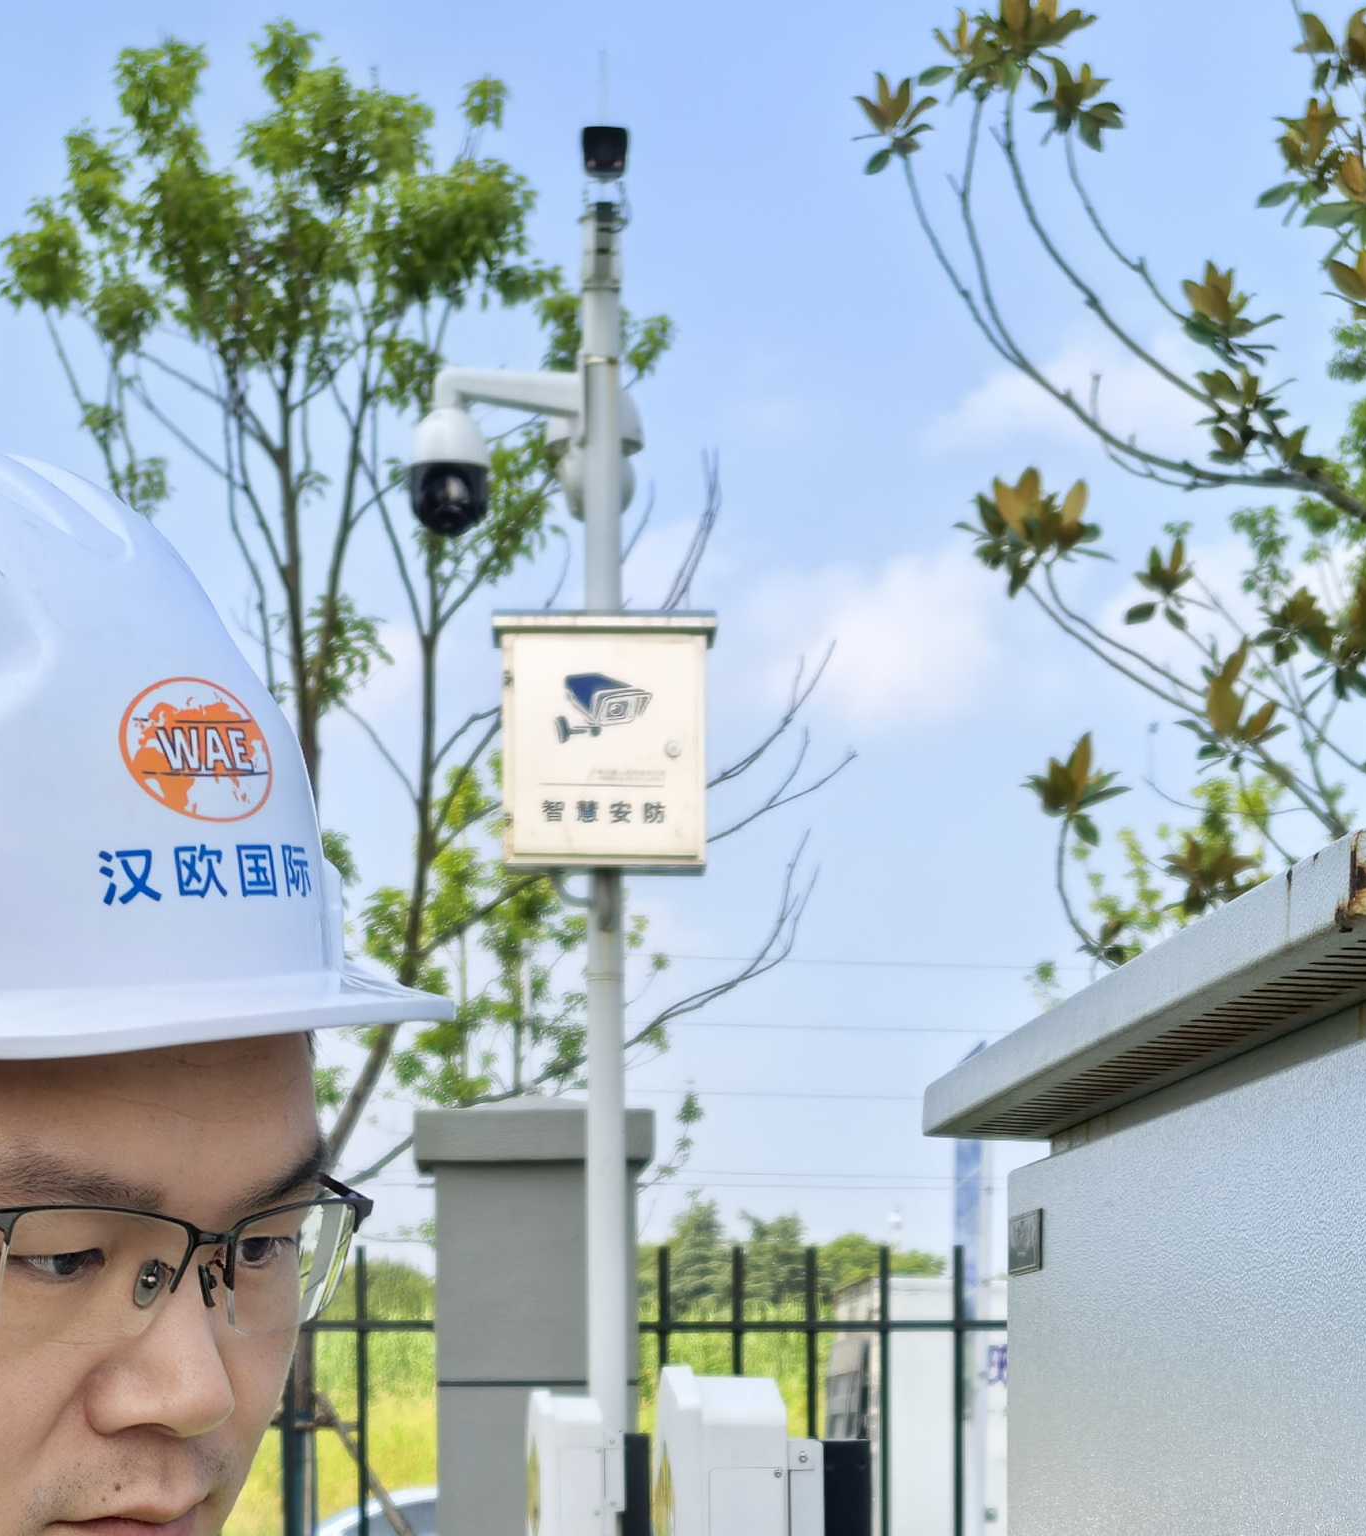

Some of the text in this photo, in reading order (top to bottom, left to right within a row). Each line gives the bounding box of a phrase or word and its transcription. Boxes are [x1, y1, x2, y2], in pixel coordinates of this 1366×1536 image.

[155, 727, 255, 773] WAE
[541, 800, 666, 824] 智慧安防
[98, 844, 313, 906] 汉欧国际
